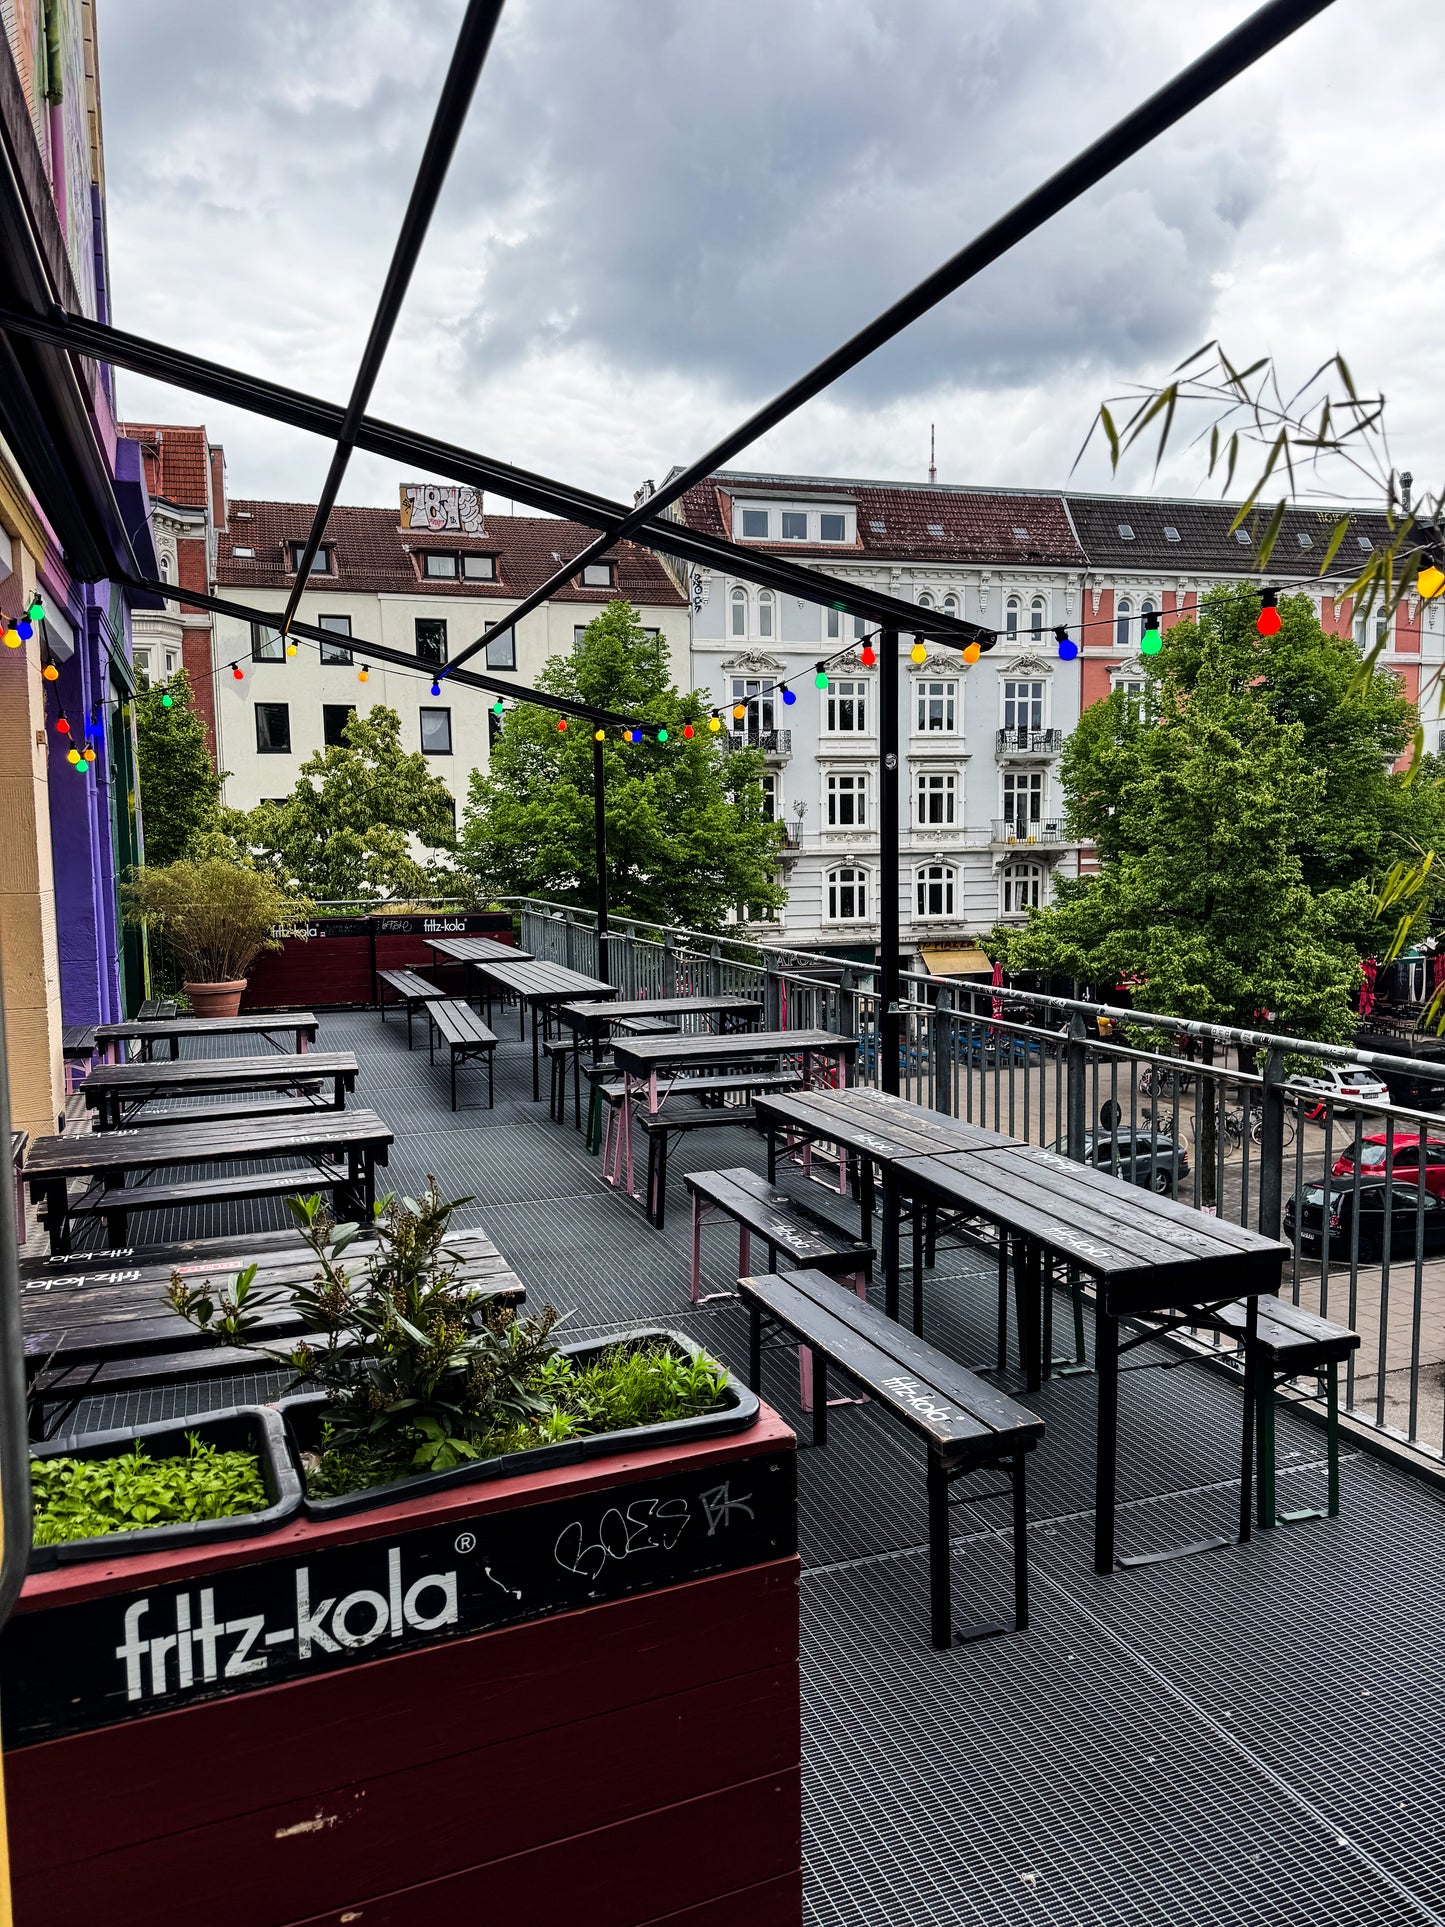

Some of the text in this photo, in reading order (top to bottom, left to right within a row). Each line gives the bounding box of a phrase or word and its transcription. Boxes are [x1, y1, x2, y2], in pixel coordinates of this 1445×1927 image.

[424, 918, 466, 933] fritz-kola
[934, 941, 975, 949] PIAZZA
[26, 1270, 142, 1290] fritz-kola
[881, 1376, 953, 1424] fritz-kola
